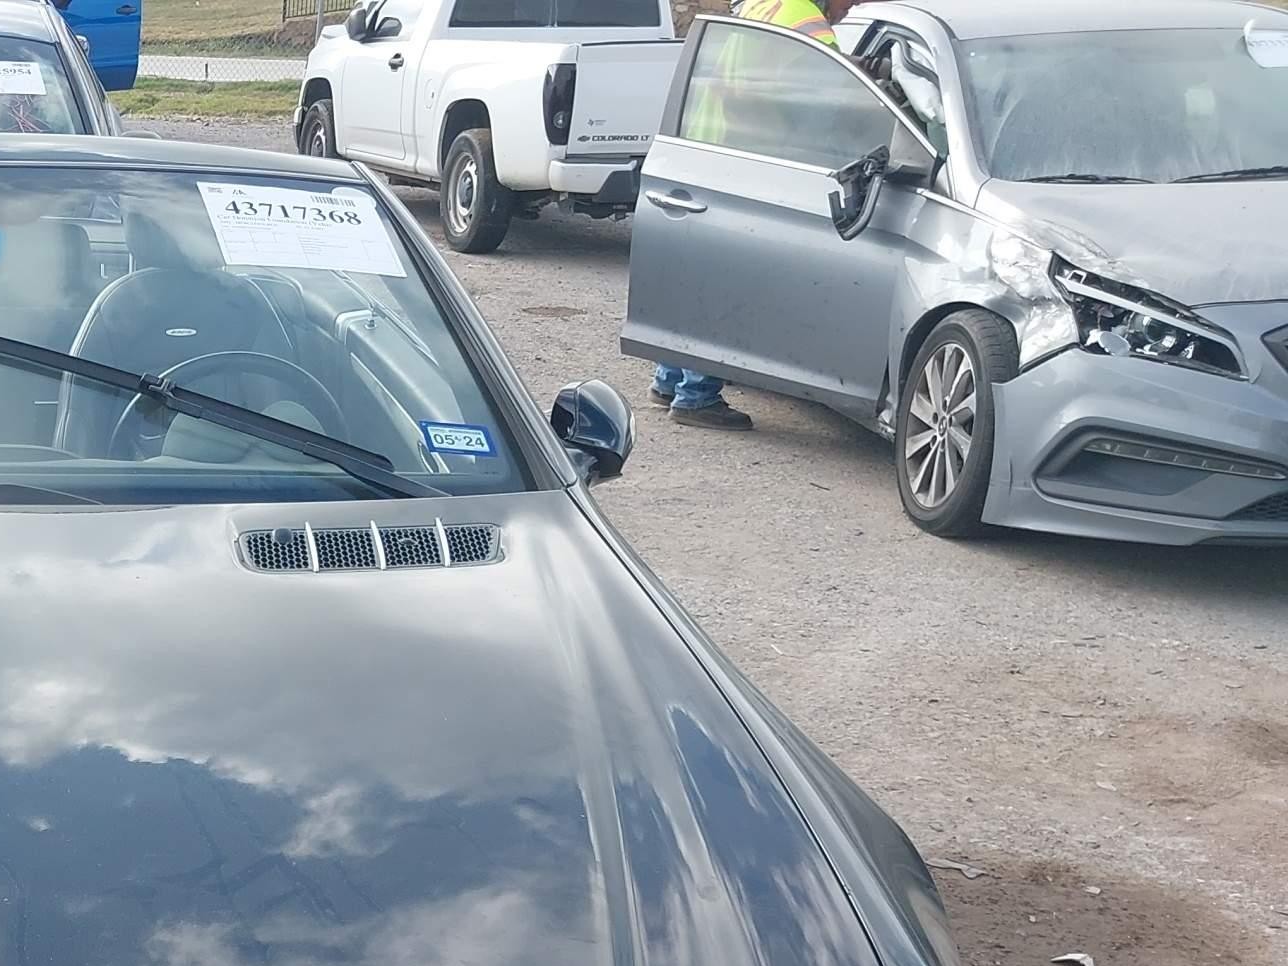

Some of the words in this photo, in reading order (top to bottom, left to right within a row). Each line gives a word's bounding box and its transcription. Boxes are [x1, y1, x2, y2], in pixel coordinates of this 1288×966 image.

[225, 200, 362, 226] 43717368
[433, 433, 455, 446] 05
[463, 435, 485, 448] 24
